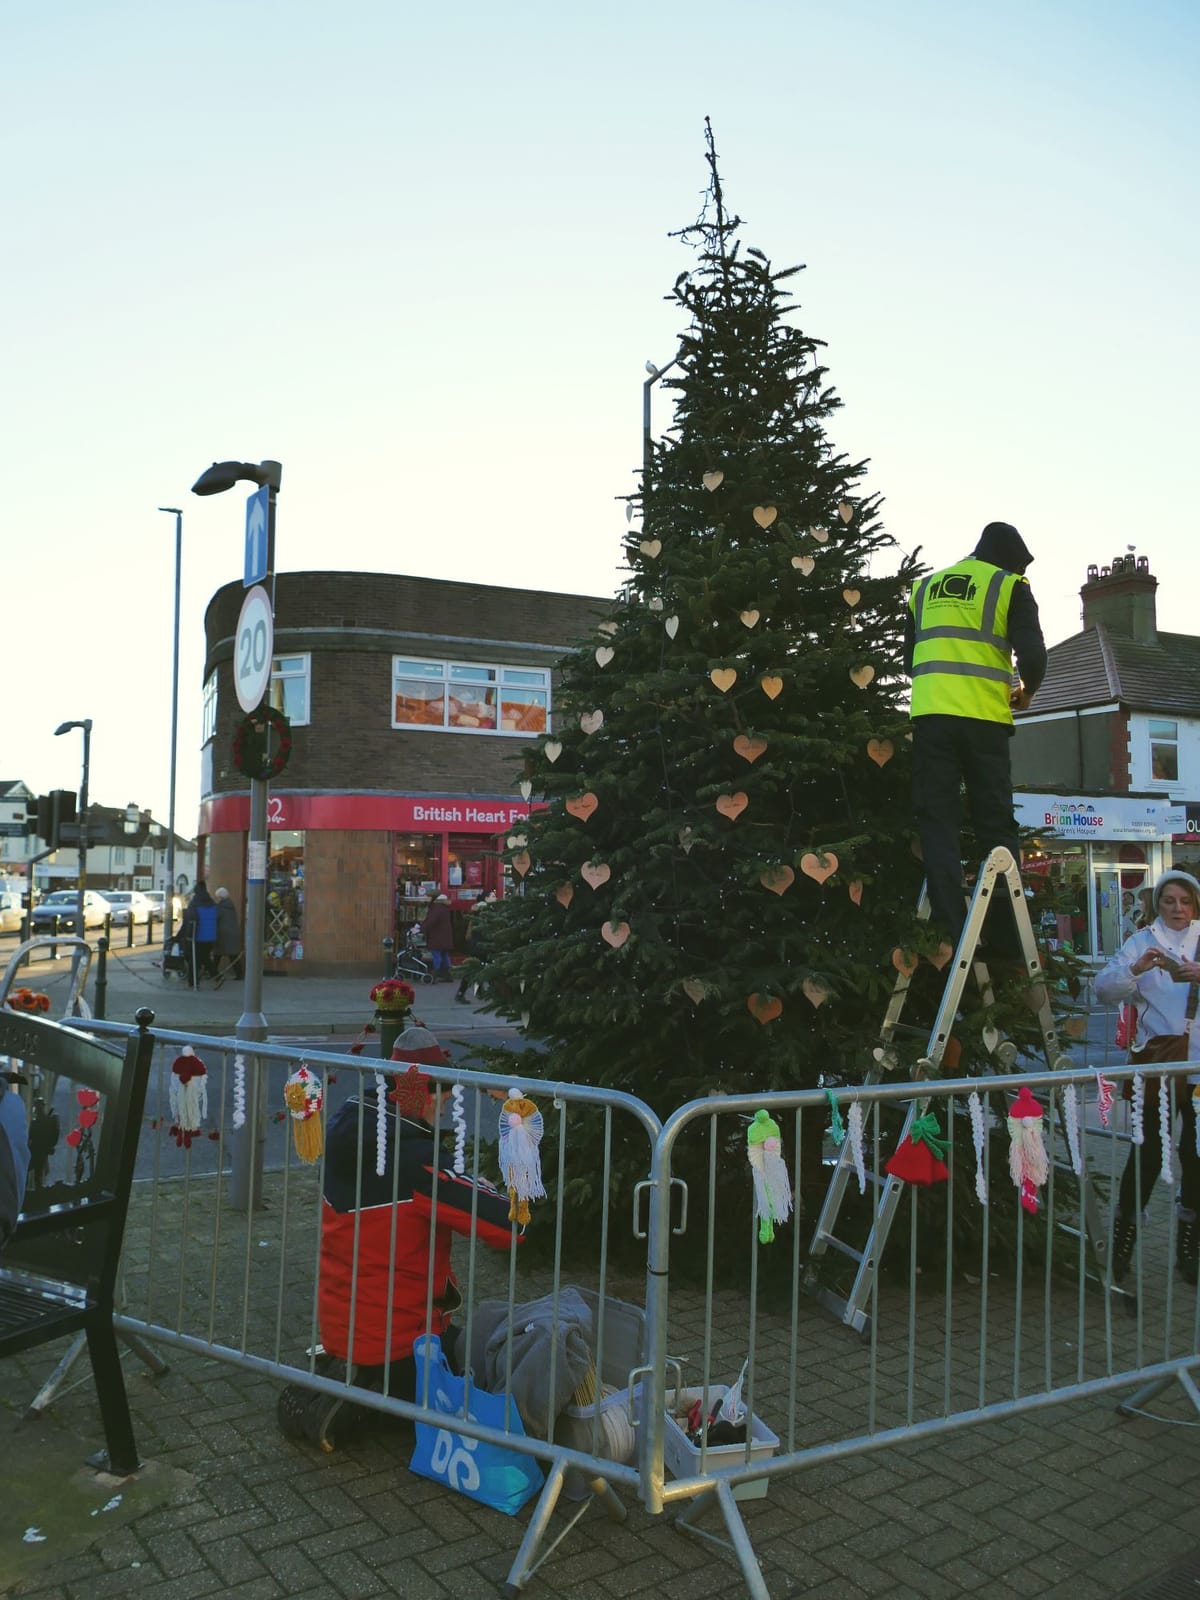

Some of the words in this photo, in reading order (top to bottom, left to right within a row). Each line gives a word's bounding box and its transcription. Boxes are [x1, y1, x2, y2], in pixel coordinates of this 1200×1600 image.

[240, 619, 267, 680] 20
[413, 806, 462, 821] British
[465, 807, 506, 823] Heart
[1044, 812, 1072, 825] Brian
[1073, 813, 1104, 826] House
